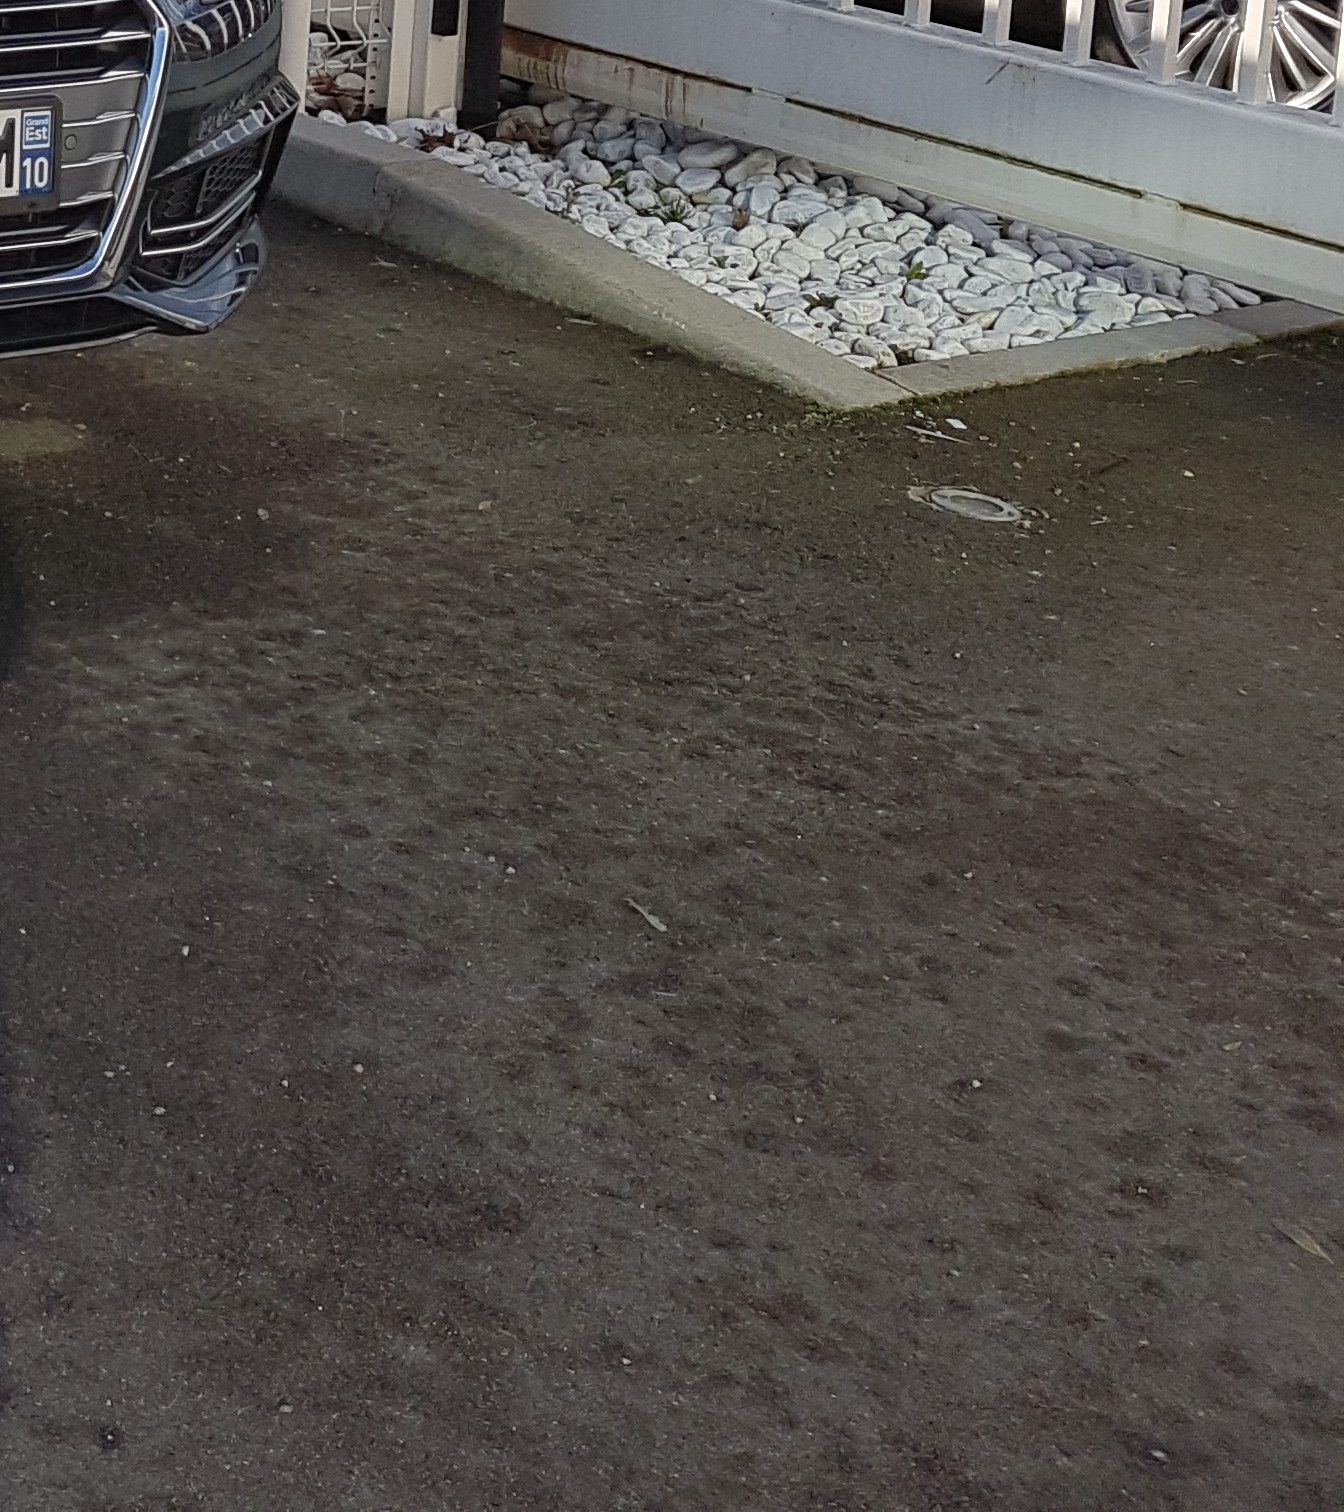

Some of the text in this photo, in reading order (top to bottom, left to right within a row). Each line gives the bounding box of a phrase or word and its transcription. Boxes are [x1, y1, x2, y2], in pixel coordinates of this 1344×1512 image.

[25, 117, 49, 127] Grand
[25, 127, 48, 142] Est
[23, 156, 49, 189] 10
